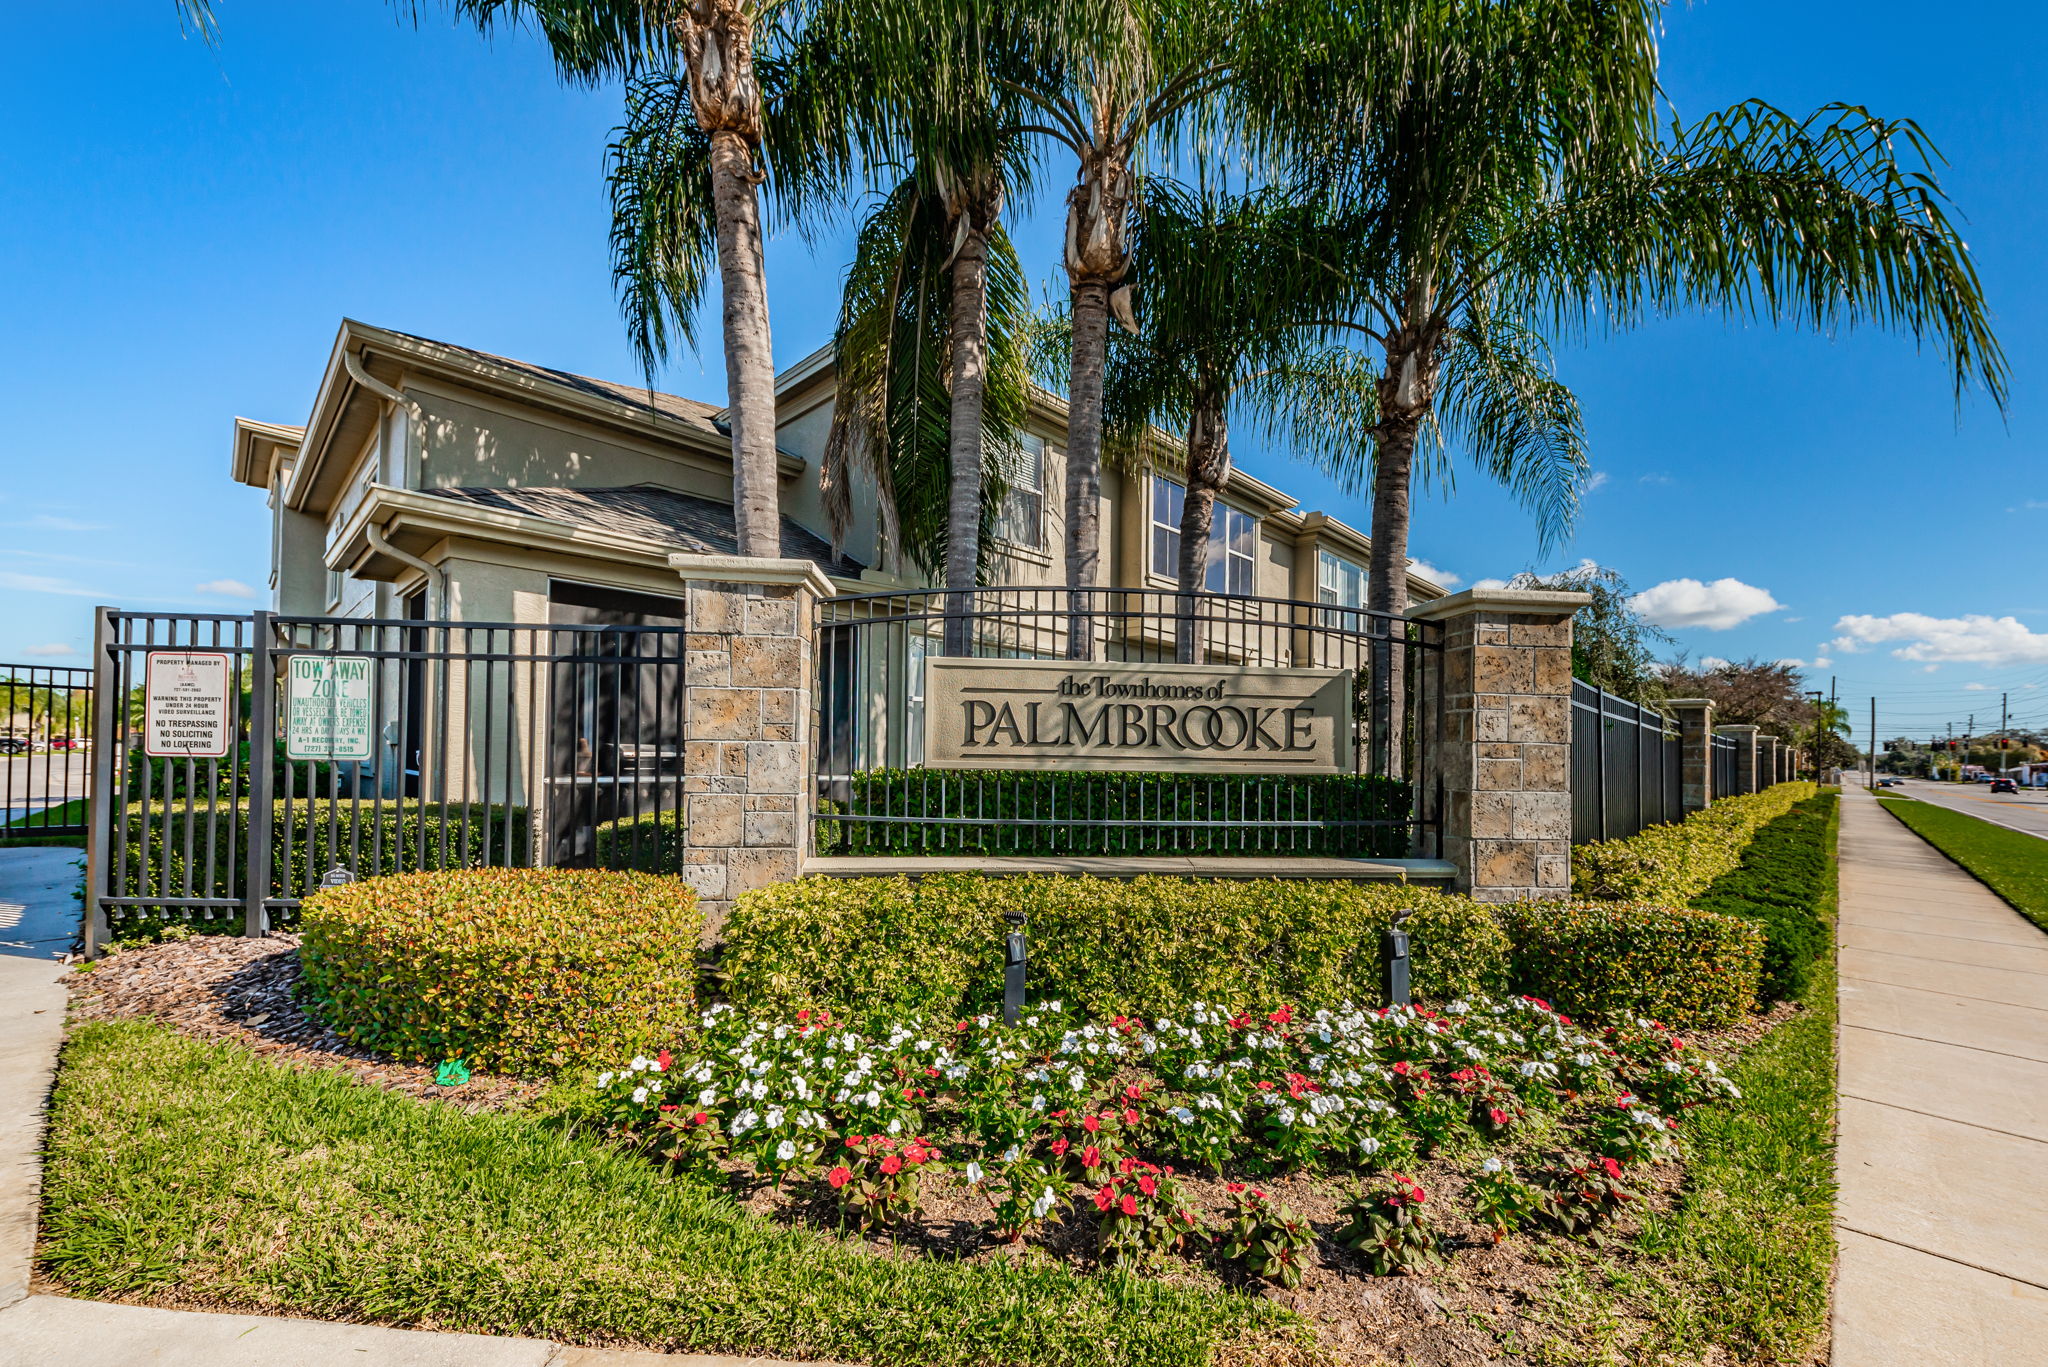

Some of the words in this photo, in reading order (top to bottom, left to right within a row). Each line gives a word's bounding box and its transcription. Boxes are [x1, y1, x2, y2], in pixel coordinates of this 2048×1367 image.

[294, 660, 323, 678] TOW
[331, 662, 366, 680] AWAY
[312, 680, 348, 698] ZONE
[1060, 675, 1091, 696] the
[1092, 676, 1203, 700] Townhomes
[1207, 680, 1226, 700] of
[293, 707, 300, 716] OR
[303, 708, 325, 716] VESSELS
[340, 709, 347, 717] BE
[350, 709, 366, 717] TOWED
[340, 699, 367, 707] VEHICLES
[293, 717, 307, 726] AWAY
[310, 718, 316, 726] AT
[342, 718, 366, 727] EXPENSE
[960, 700, 1317, 752] PALMBROOKE
